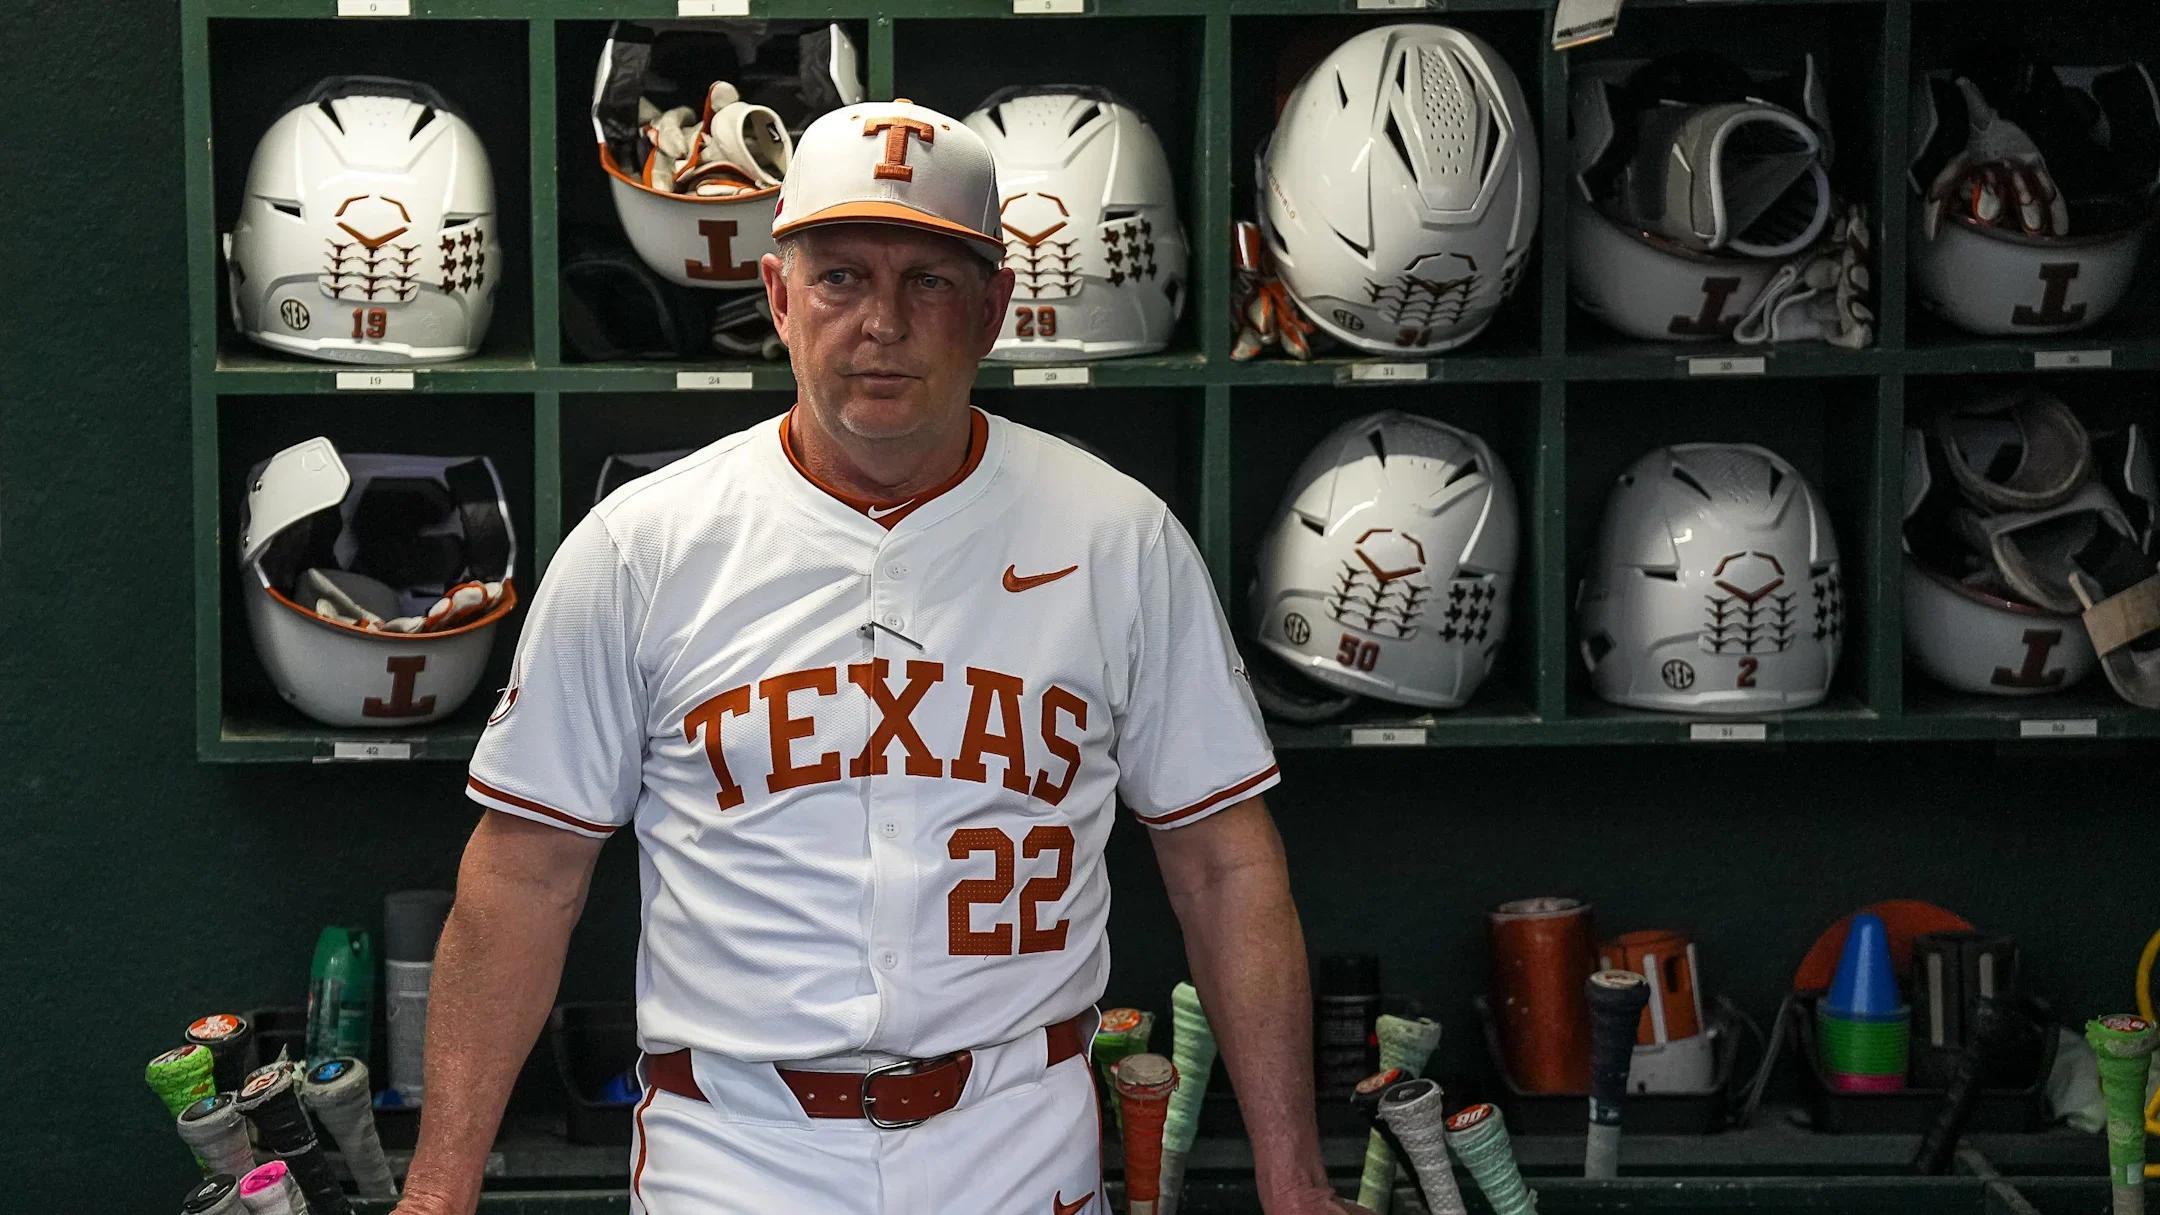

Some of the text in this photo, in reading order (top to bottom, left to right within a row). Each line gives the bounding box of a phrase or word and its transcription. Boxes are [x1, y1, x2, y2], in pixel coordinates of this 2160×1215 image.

[862, 116, 935, 183] T
[684, 219, 758, 279] T
[2012, 263, 2087, 327] T
[282, 301, 310, 329] SEC
[351, 307, 387, 339] 19
[1015, 305, 1057, 338] 29
[369, 376, 382, 385] 19
[708, 376, 721, 385] 24
[1044, 372, 1057, 381] 29
[1383, 367, 1395, 376] 31
[1285, 614, 1310, 644] SEC
[1336, 633, 1381, 672] 50
[1991, 630, 2067, 687] T
[362, 656, 436, 718] T
[1662, 660, 1694, 689] SEC
[1737, 656, 1758, 688] 2
[683, 657, 1088, 811] TEXAS
[365, 746, 379, 755] 42
[947, 825, 1075, 956] 22
